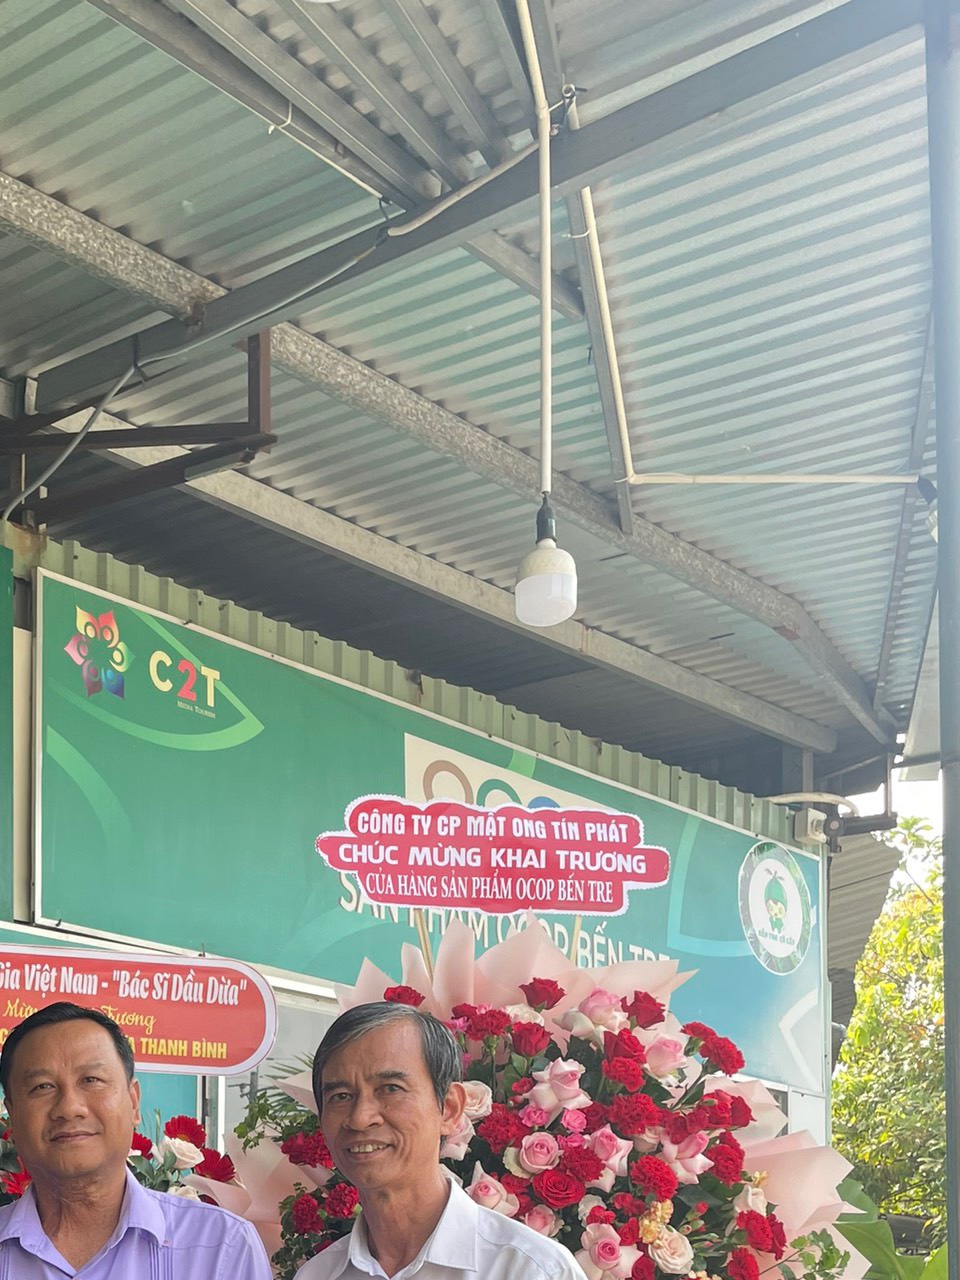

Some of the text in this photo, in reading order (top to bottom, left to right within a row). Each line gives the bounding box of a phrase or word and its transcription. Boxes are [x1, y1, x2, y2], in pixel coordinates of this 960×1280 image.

[149, 650, 220, 707] C2T
[358, 809, 628, 843] CÔNG TY CP MẬT ONG TÍN PHÁT
[339, 841, 646, 874] CHÚC MỪNG KHAI TRƯƠNG
[397, 870, 437, 897] HÀNG
[441, 870, 469, 898] SẢN
[516, 877, 554, 900] OCOP
[558, 873, 584, 901] BẾN
[588, 881, 613, 903] TRE
[577, 921, 623, 968] BẾN
[24, 964, 57, 998] Việt
[59, 966, 98, 998] Nam
[113, 970, 150, 999] "Bác
[152, 972, 170, 1000] Sĩ
[171, 969, 203, 1003] Dầu
[206, 976, 247, 1006] Dừa"
[140, 1037, 188, 1057] THANH
[192, 1038, 227, 1059] BÌNH
